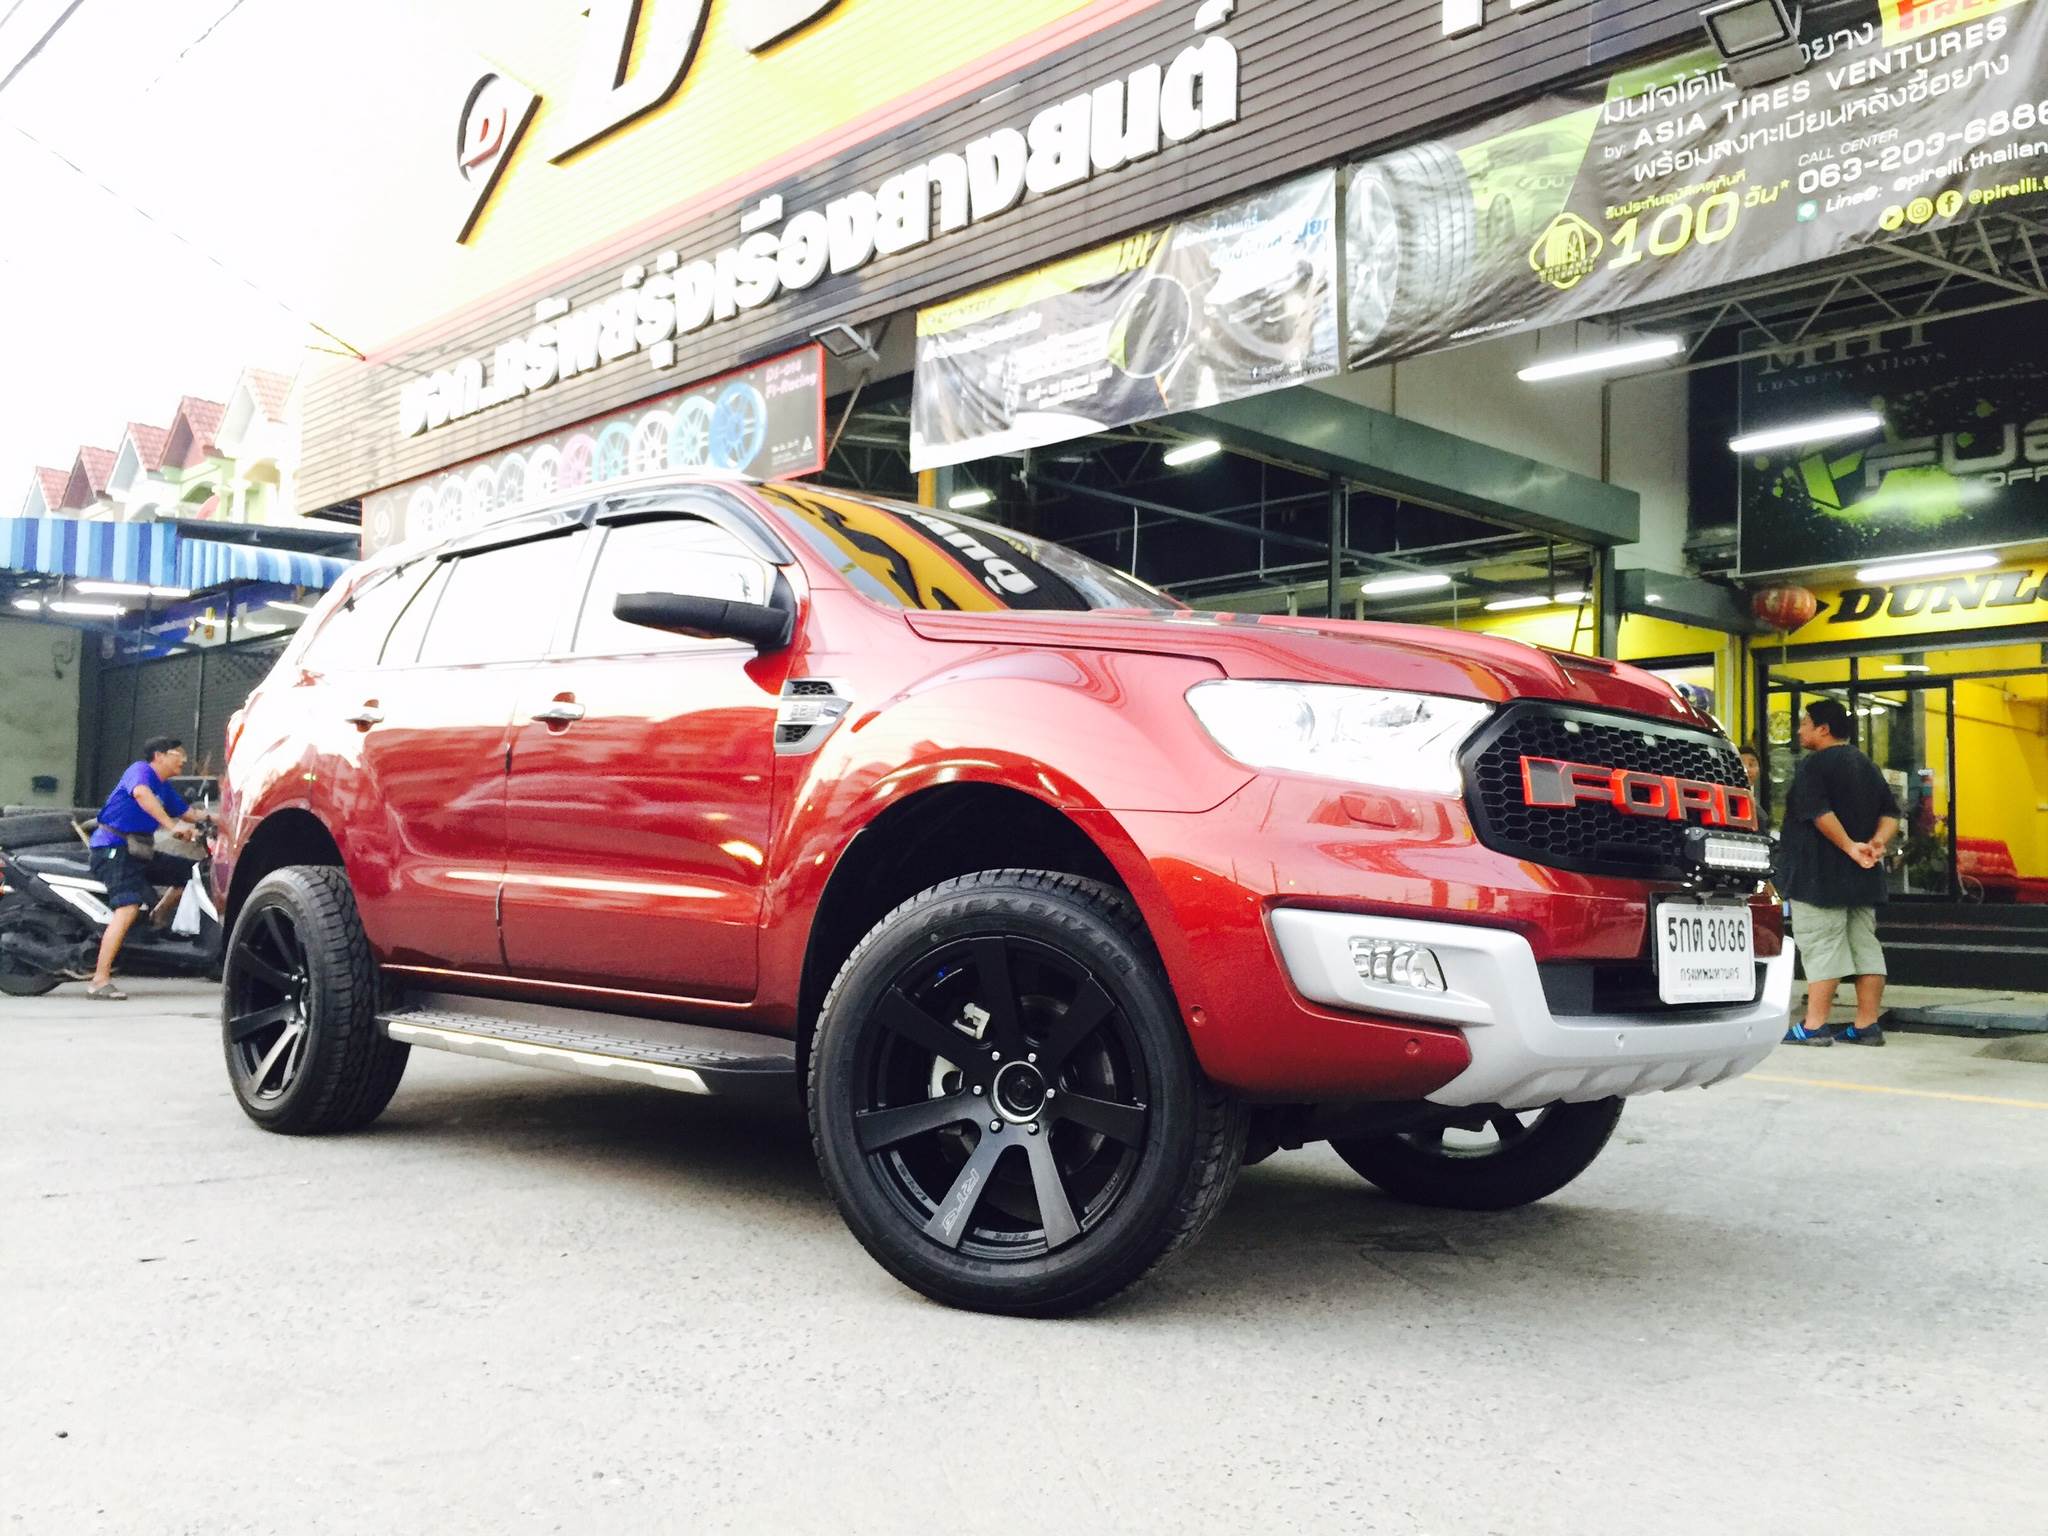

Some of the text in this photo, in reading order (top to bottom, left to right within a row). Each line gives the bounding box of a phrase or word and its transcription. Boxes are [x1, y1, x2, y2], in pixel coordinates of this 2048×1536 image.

[1633, 113, 1707, 150] ASIA
[1721, 80, 1811, 124] TIRES
[1826, 16, 2008, 91] VENTURES
[1798, 128, 1899, 167] CALL CENTER
[1607, 191, 1740, 270] 100
[1828, 569, 2048, 624] DUNL
[1520, 756, 1759, 832] FORD
[1708, 917, 1746, 953] 3036
